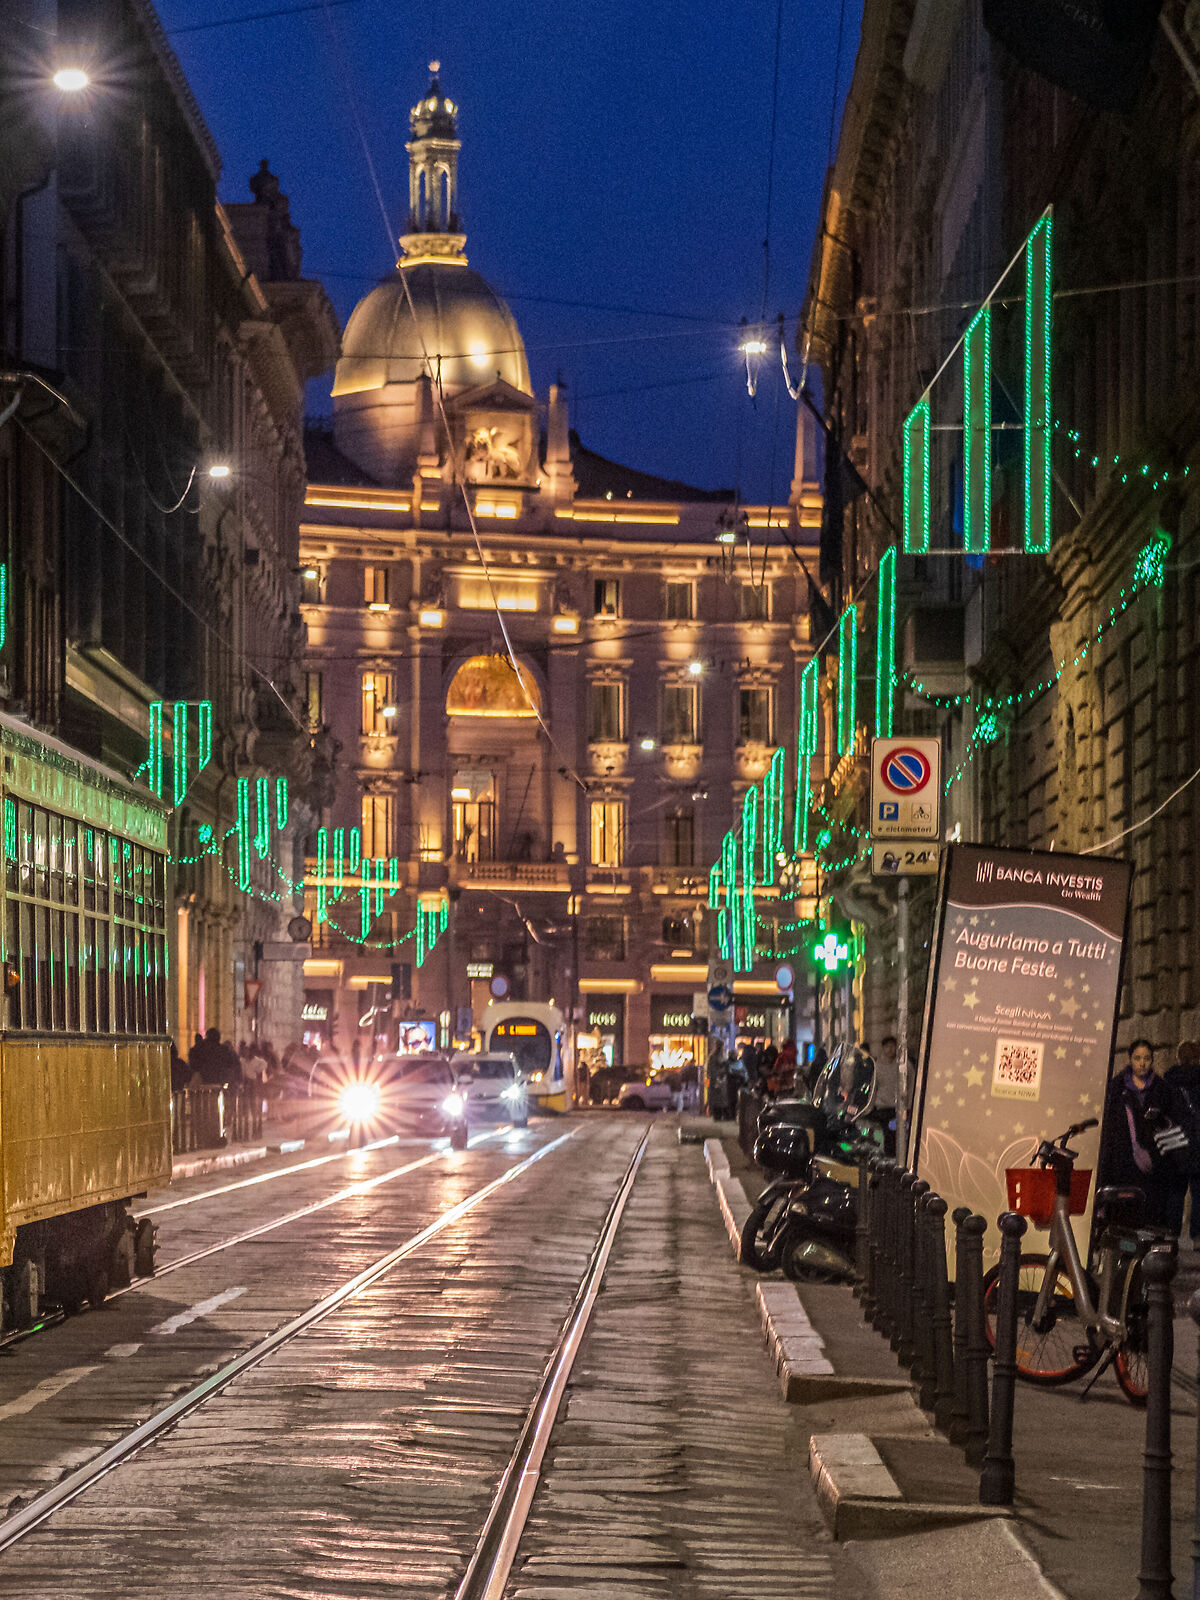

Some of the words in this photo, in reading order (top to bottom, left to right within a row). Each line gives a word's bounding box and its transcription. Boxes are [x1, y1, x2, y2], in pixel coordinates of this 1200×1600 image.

[997, 866, 1043, 885] BANCA
[1046, 872, 1103, 891] INVESTIS
[1061, 889, 1073, 898] Go
[1074, 890, 1101, 901] Wealth
[956, 927, 1049, 953] Auguriamo
[1052, 941, 1063, 955] a
[1068, 937, 1107, 960] Tutti
[954, 950, 1008, 973] Buone
[1011, 955, 1058, 979] Feste.
[995, 1004, 1020, 1018] Scegli
[1021, 1009, 1051, 1020] NIWA
